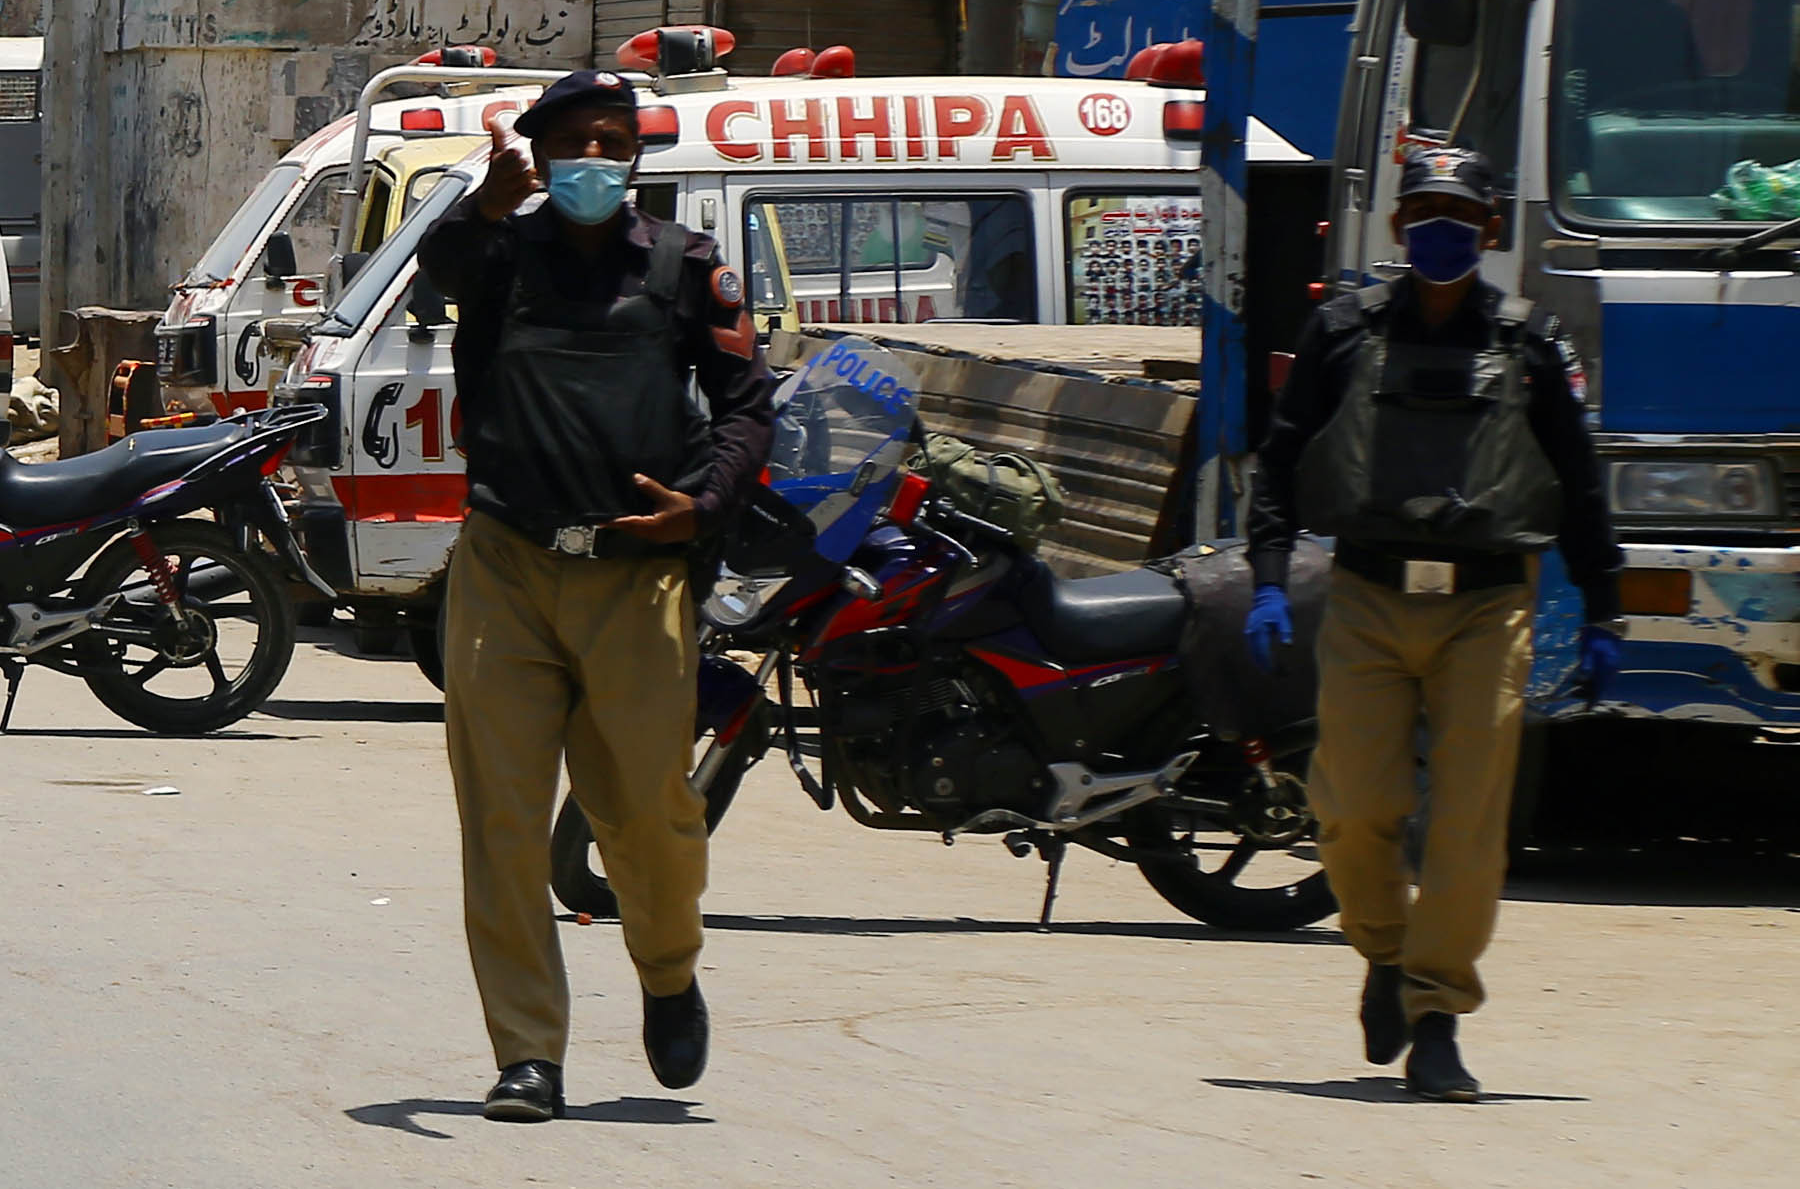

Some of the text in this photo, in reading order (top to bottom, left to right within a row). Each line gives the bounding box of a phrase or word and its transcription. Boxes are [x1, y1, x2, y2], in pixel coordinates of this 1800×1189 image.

[705, 94, 1128, 163] CHHIPA 168
[821, 344, 913, 415] POLICE
